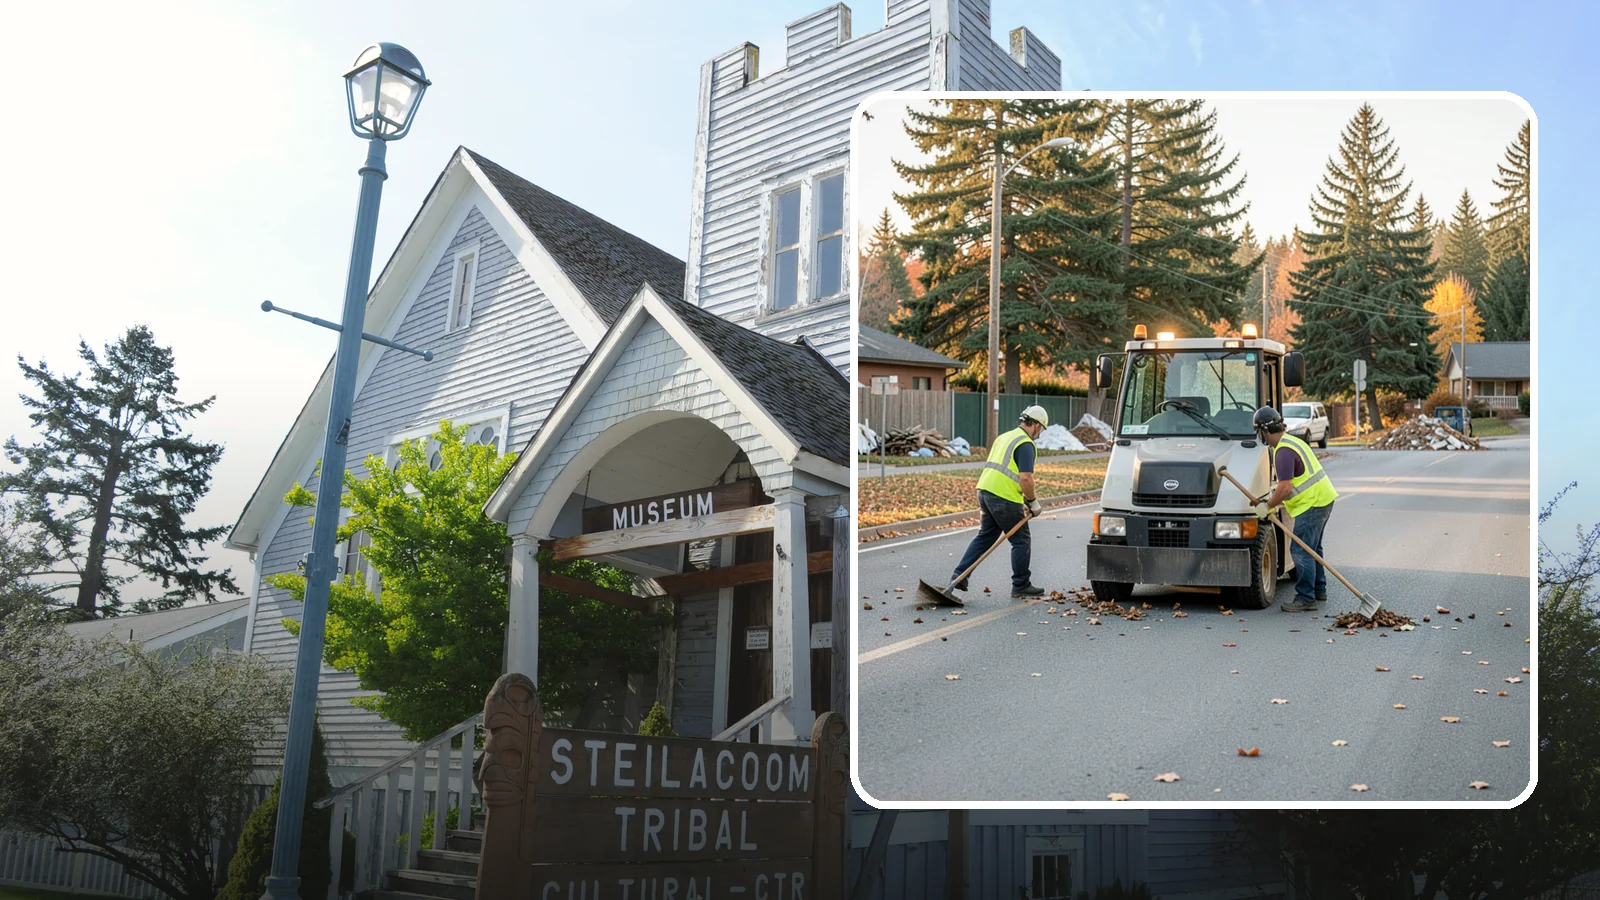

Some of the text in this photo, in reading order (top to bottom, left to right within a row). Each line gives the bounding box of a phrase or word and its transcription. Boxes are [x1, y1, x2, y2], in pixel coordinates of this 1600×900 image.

[612, 491, 714, 531] MUSEUM
[550, 737, 809, 793] STEILACOOM
[614, 806, 758, 852] TRIBAL
